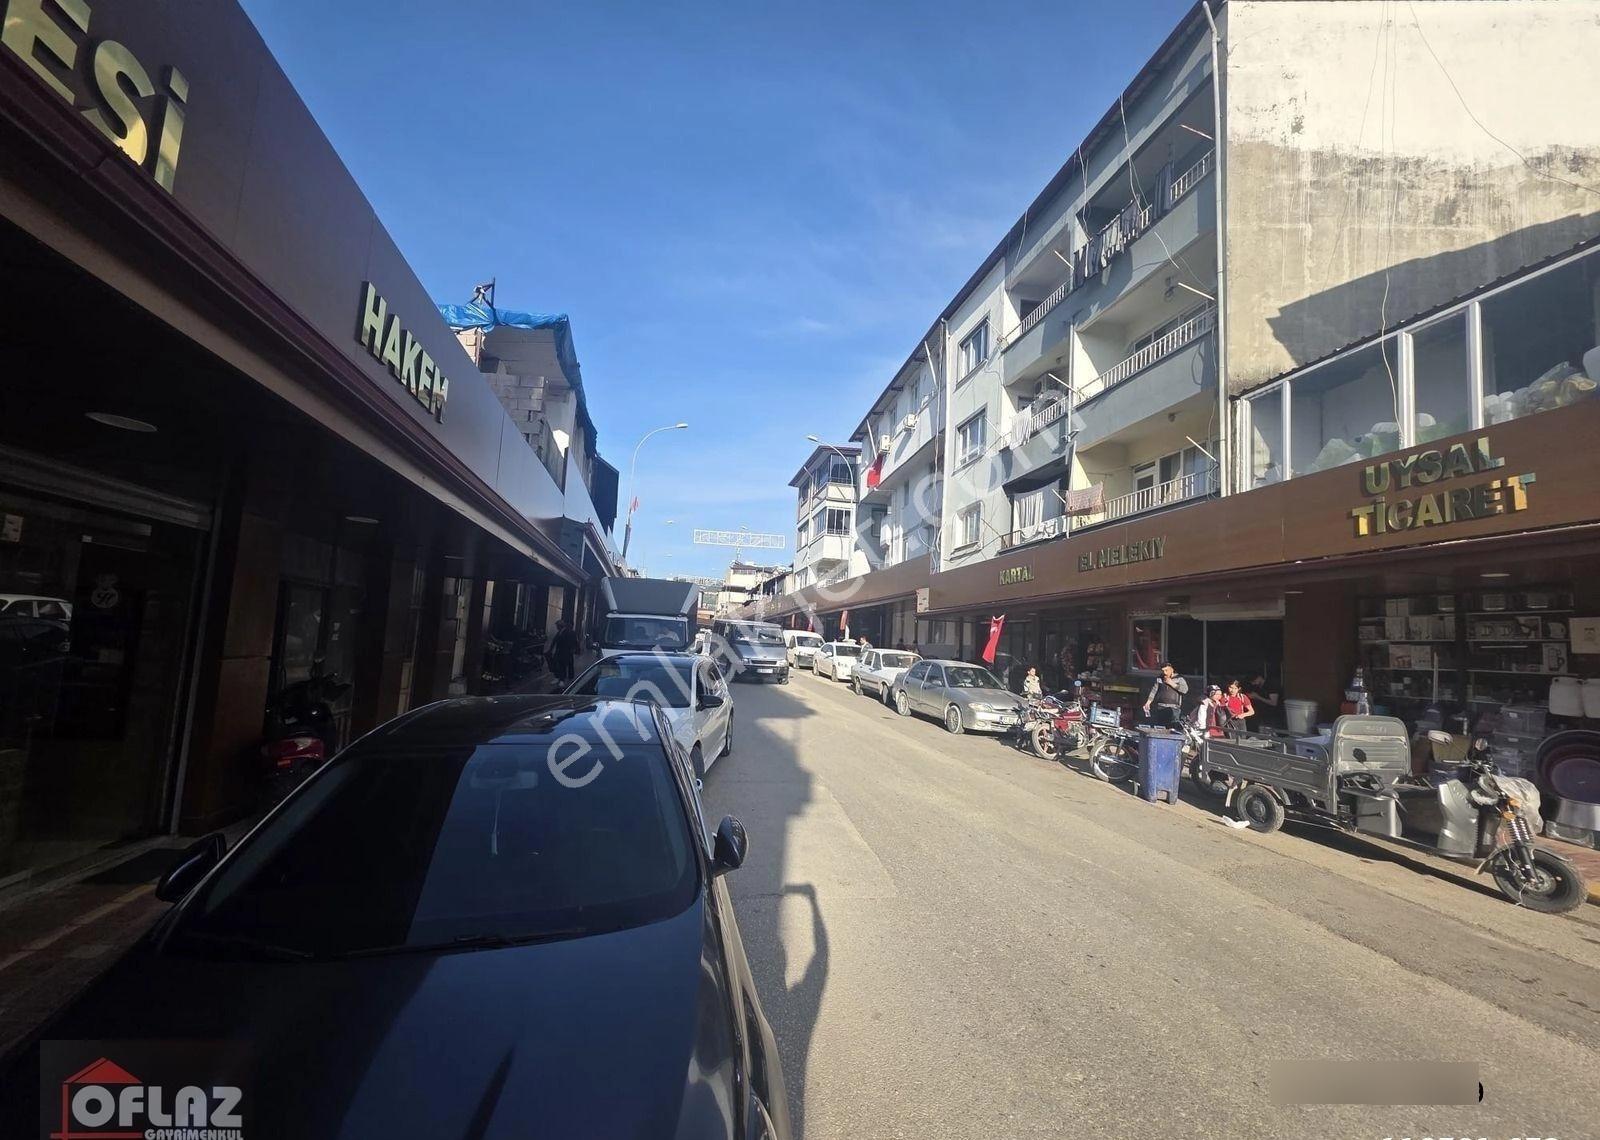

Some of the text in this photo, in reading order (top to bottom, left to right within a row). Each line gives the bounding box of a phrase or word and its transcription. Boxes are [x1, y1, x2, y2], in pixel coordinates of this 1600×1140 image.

[359, 281, 449, 424] HAKEM
[1363, 436, 1506, 494] UYSAL
[1351, 472, 1536, 536] TİCARET
[999, 566, 1034, 585] KARTAL
